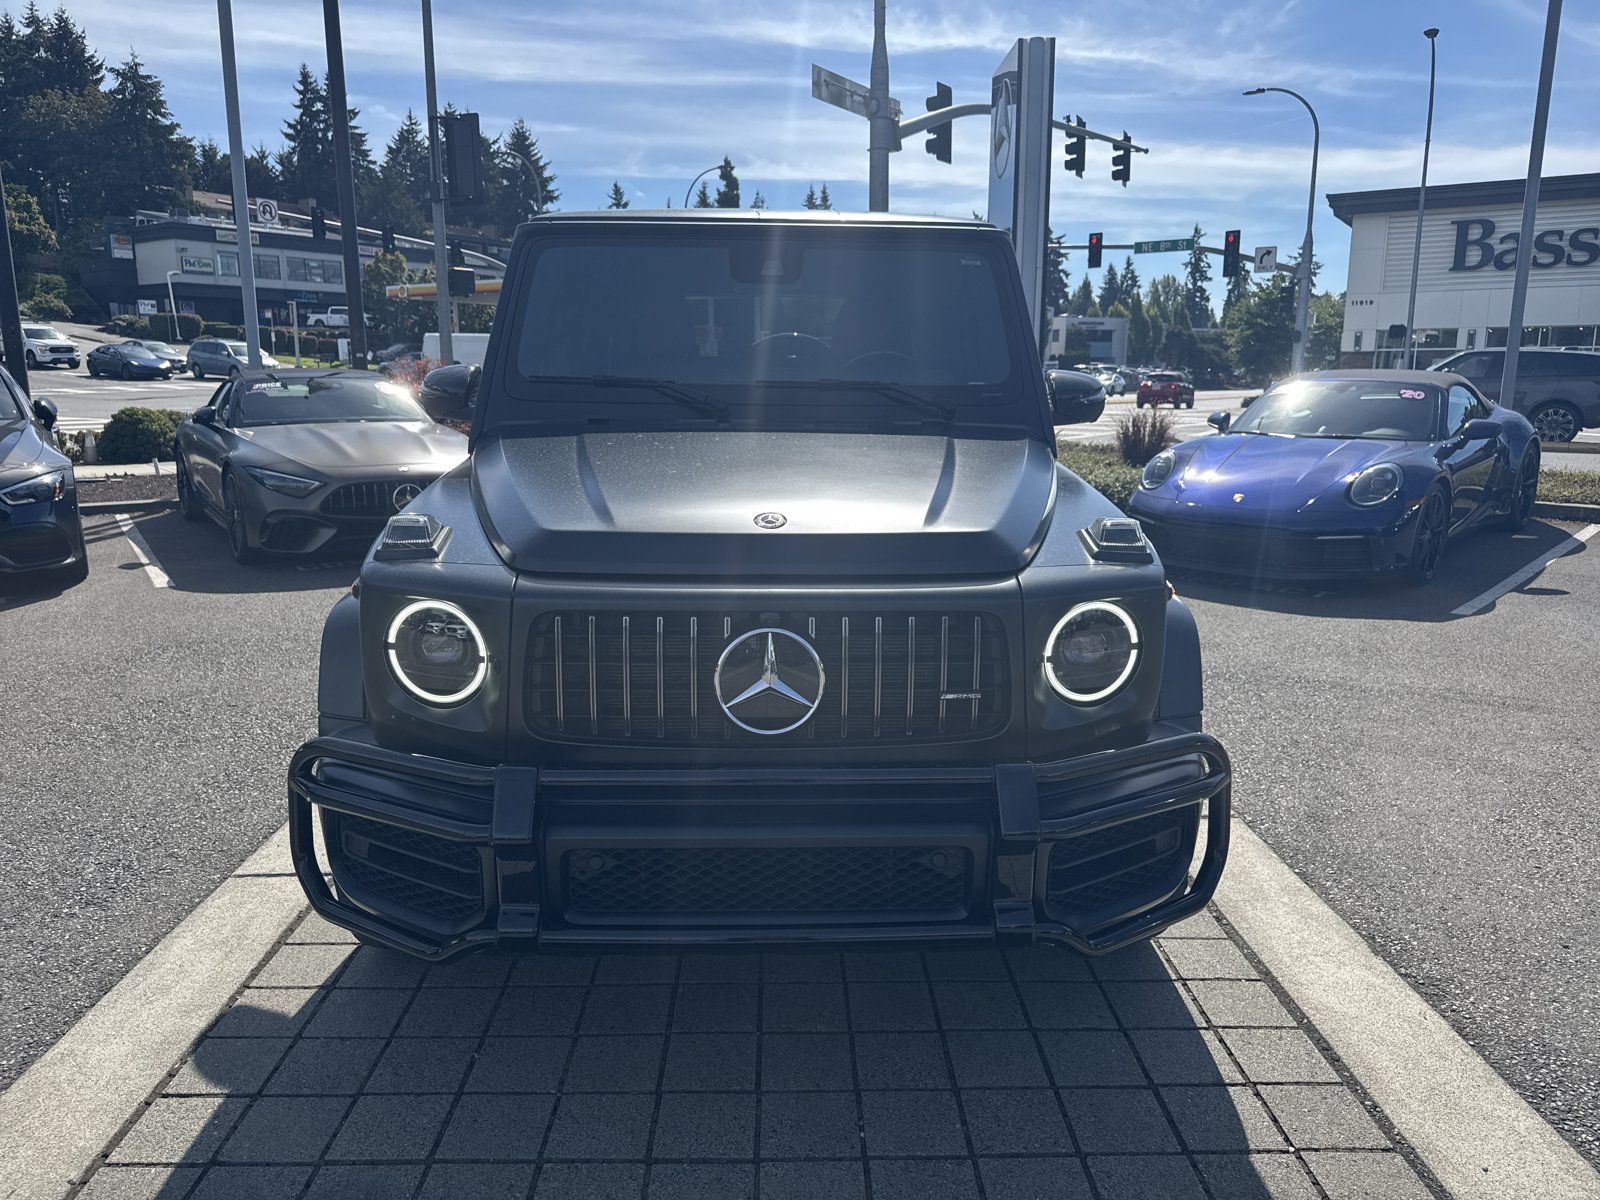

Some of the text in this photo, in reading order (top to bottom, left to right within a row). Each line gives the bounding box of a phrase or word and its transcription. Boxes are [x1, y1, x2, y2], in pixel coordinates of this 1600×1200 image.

[1141, 240, 1187, 252] NE 8th St
[1448, 218, 1600, 272] Bass
